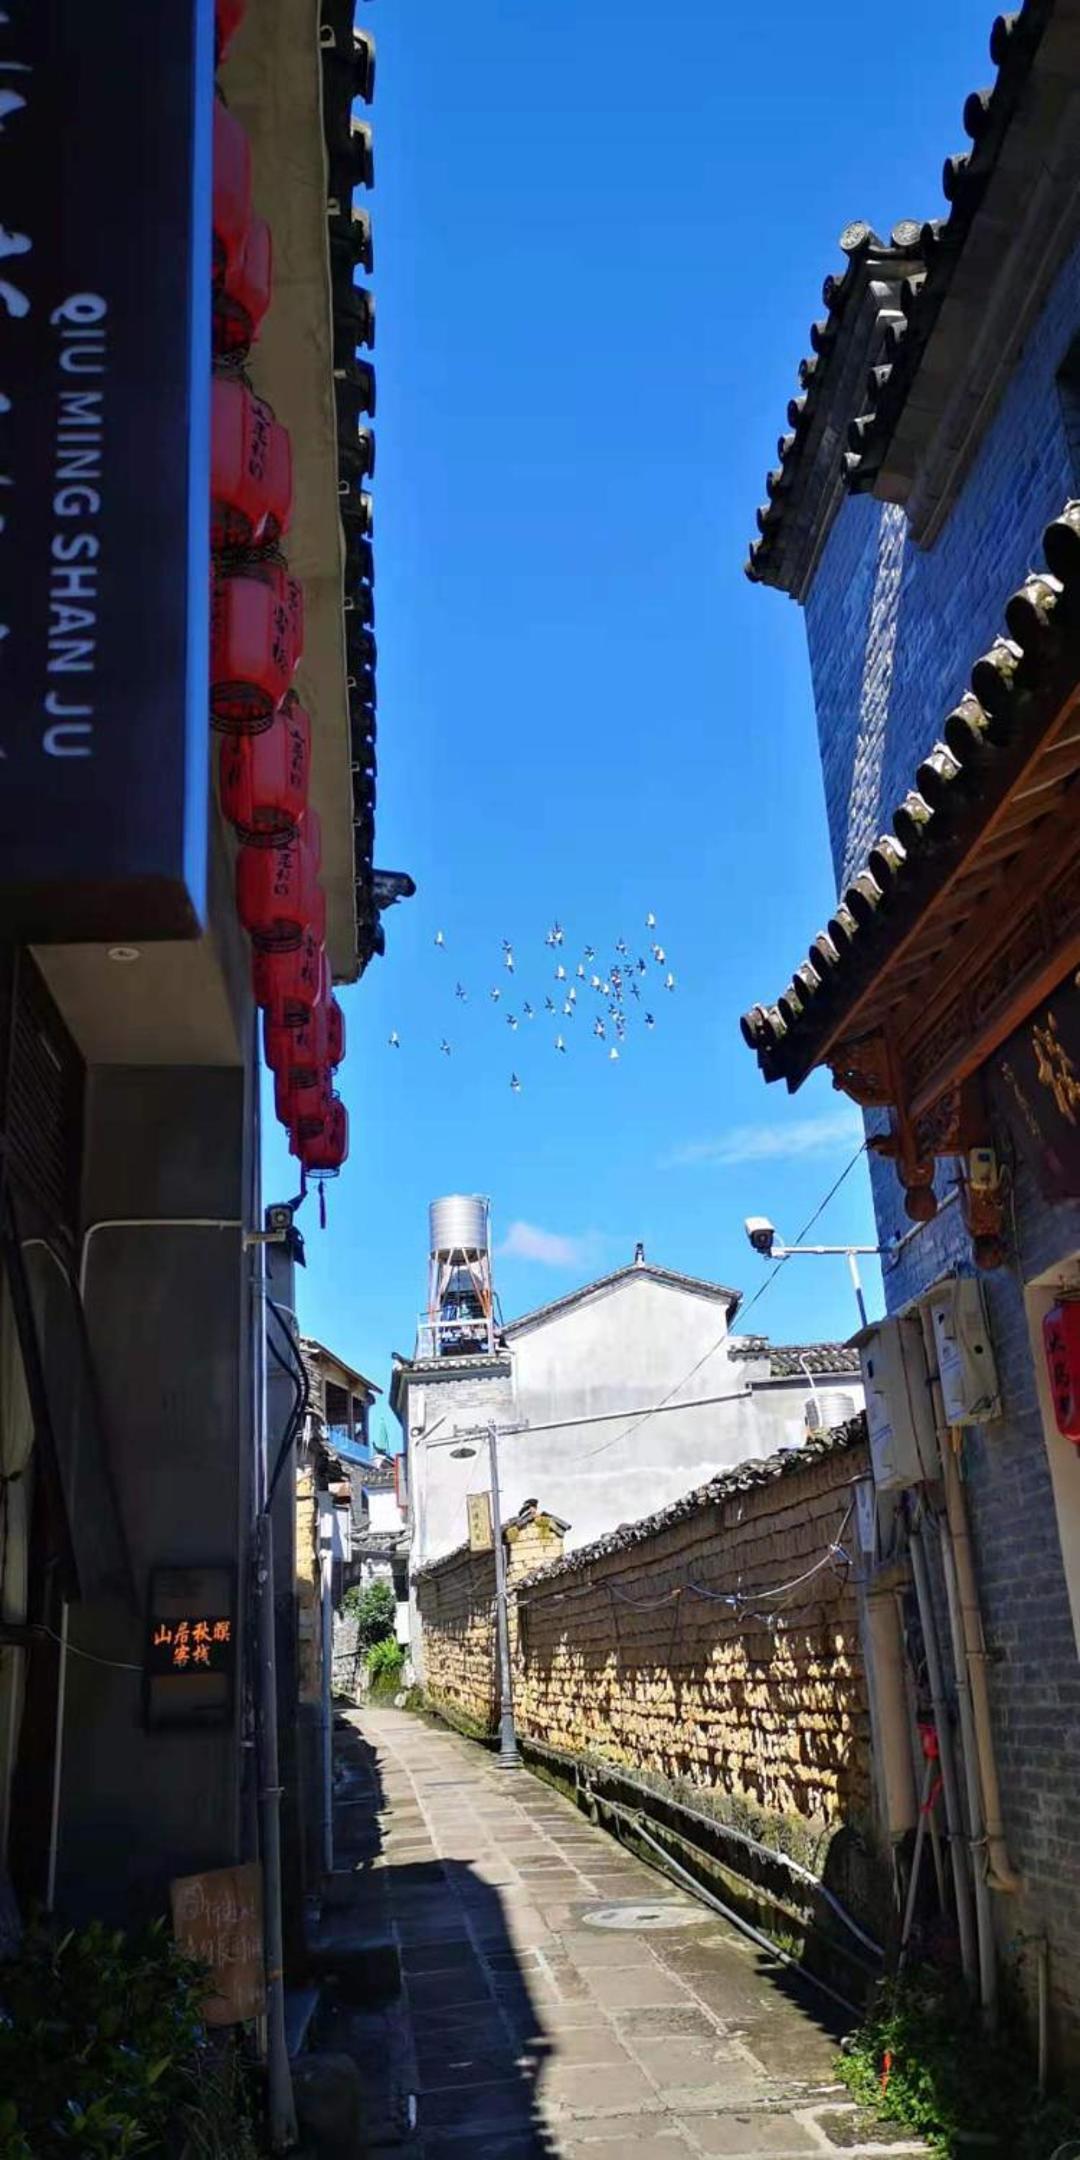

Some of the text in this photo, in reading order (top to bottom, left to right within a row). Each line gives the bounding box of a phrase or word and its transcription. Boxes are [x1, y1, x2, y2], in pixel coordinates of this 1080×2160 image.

[43, 292, 107, 756] QIU MING SHAN JU
[173, 1644, 211, 1667] 客栈
